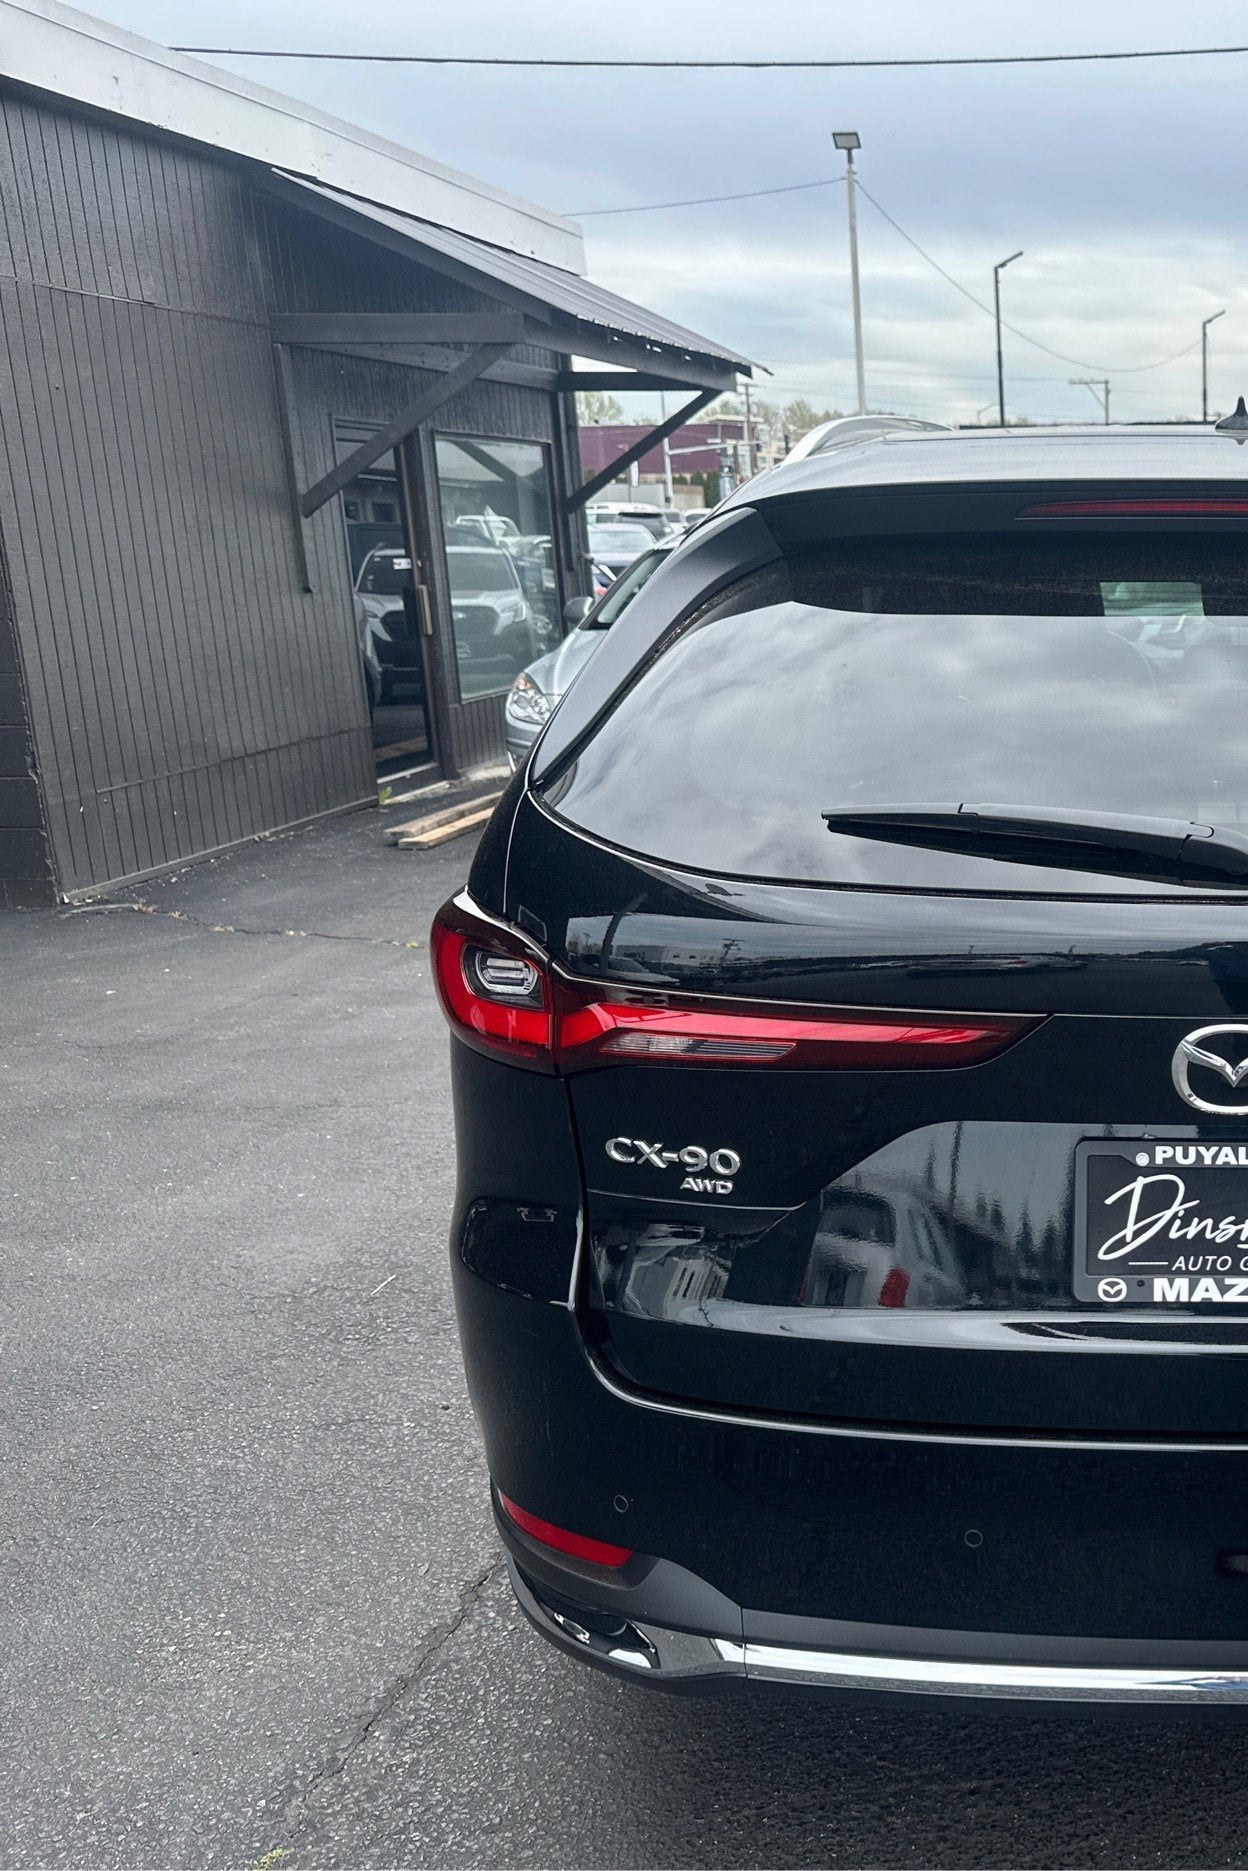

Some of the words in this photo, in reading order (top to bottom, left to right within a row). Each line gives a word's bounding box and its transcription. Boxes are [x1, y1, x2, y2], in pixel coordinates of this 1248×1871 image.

[605, 1137, 741, 1176] CX-90
[680, 1177, 734, 1195] AWD
[1171, 1255, 1233, 1271] AUTO
